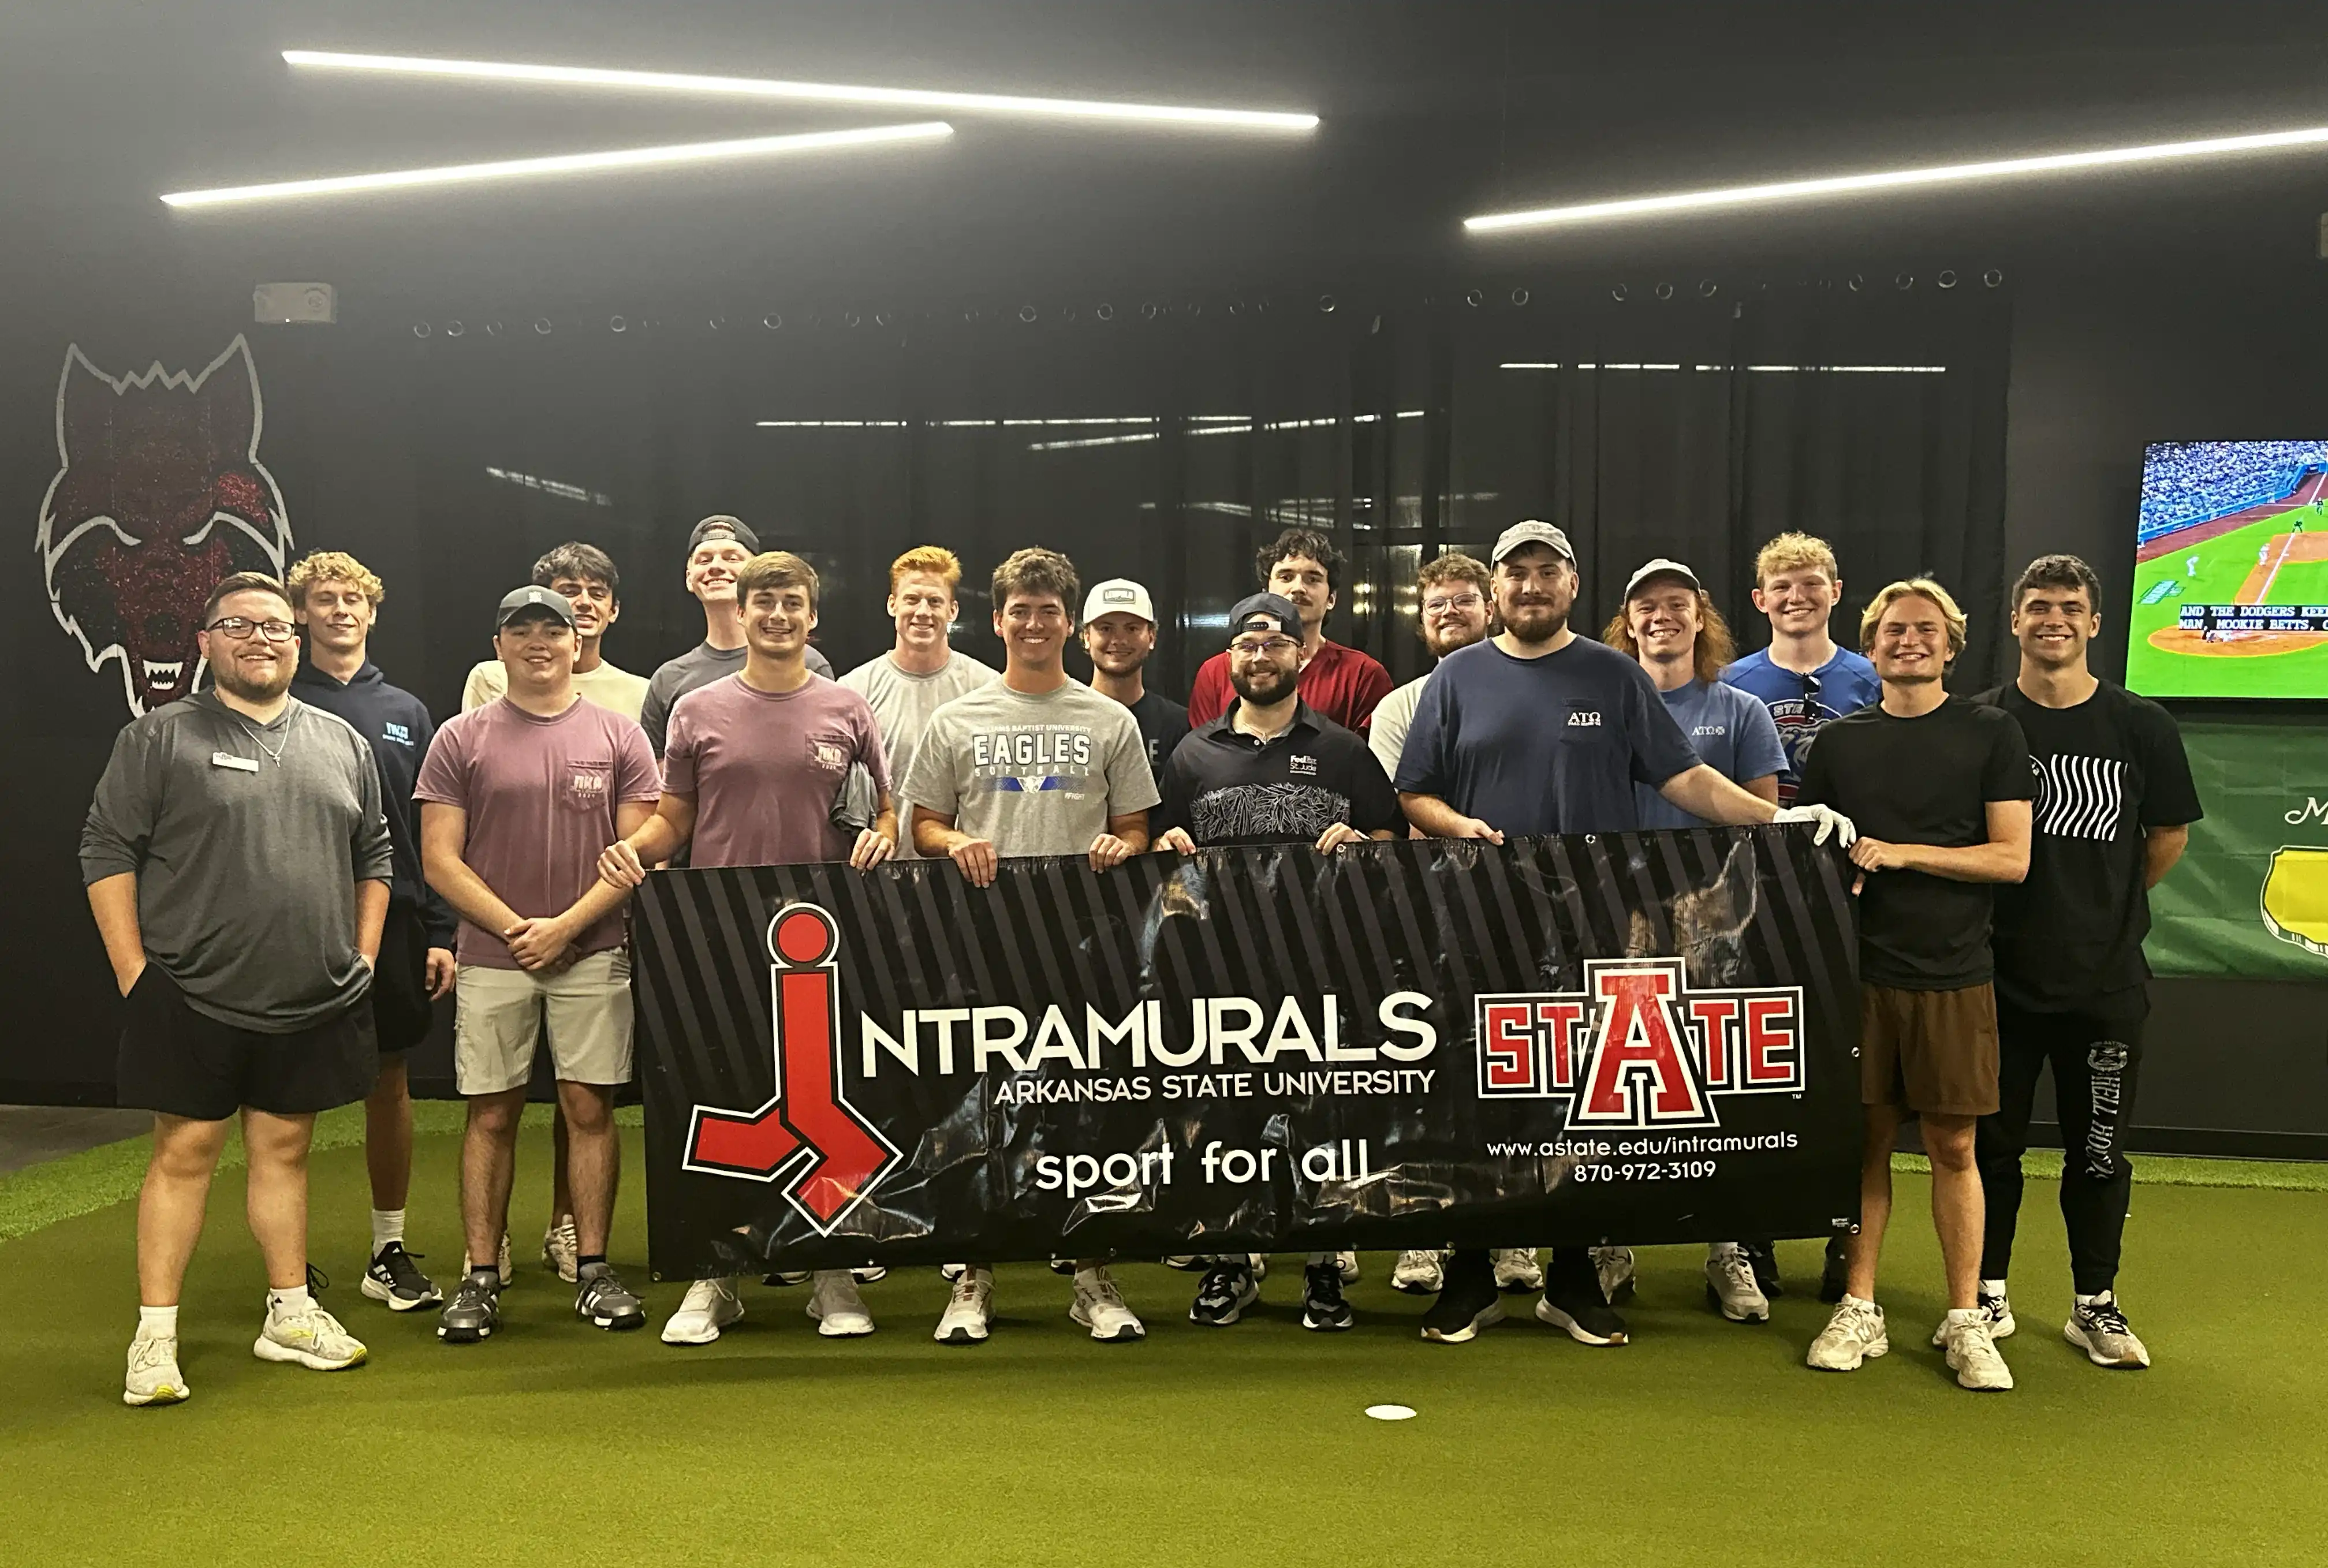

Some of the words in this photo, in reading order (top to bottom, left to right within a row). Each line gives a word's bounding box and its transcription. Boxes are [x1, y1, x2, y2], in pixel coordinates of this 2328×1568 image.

[2180, 606, 2204, 616] AND
[2210, 606, 2234, 617] THE
[2240, 606, 2295, 617] DODGERS
[2179, 619, 2208, 630] MAN,
[2216, 619, 2264, 630] MOOKIE
[2269, 619, 2315, 631] BETTS,
[1046, 725, 1091, 733] UNIVERSITY
[973, 733, 1091, 767] EAGLES
[1475, 957, 1805, 1129] STATE
[994, 1076, 1152, 1104] ARKANSAS
[1162, 1073, 1252, 1099] STATE
[1264, 1070, 1436, 1096] UNIVERSITY
[1486, 1132, 1798, 1156] www.astate.edu/intramurals
[1035, 1143, 1174, 1199] sport
[1201, 1141, 1277, 1184] for
[1301, 1139, 1368, 1182] all
[1574, 1160, 1717, 1182] 870-972-3109
